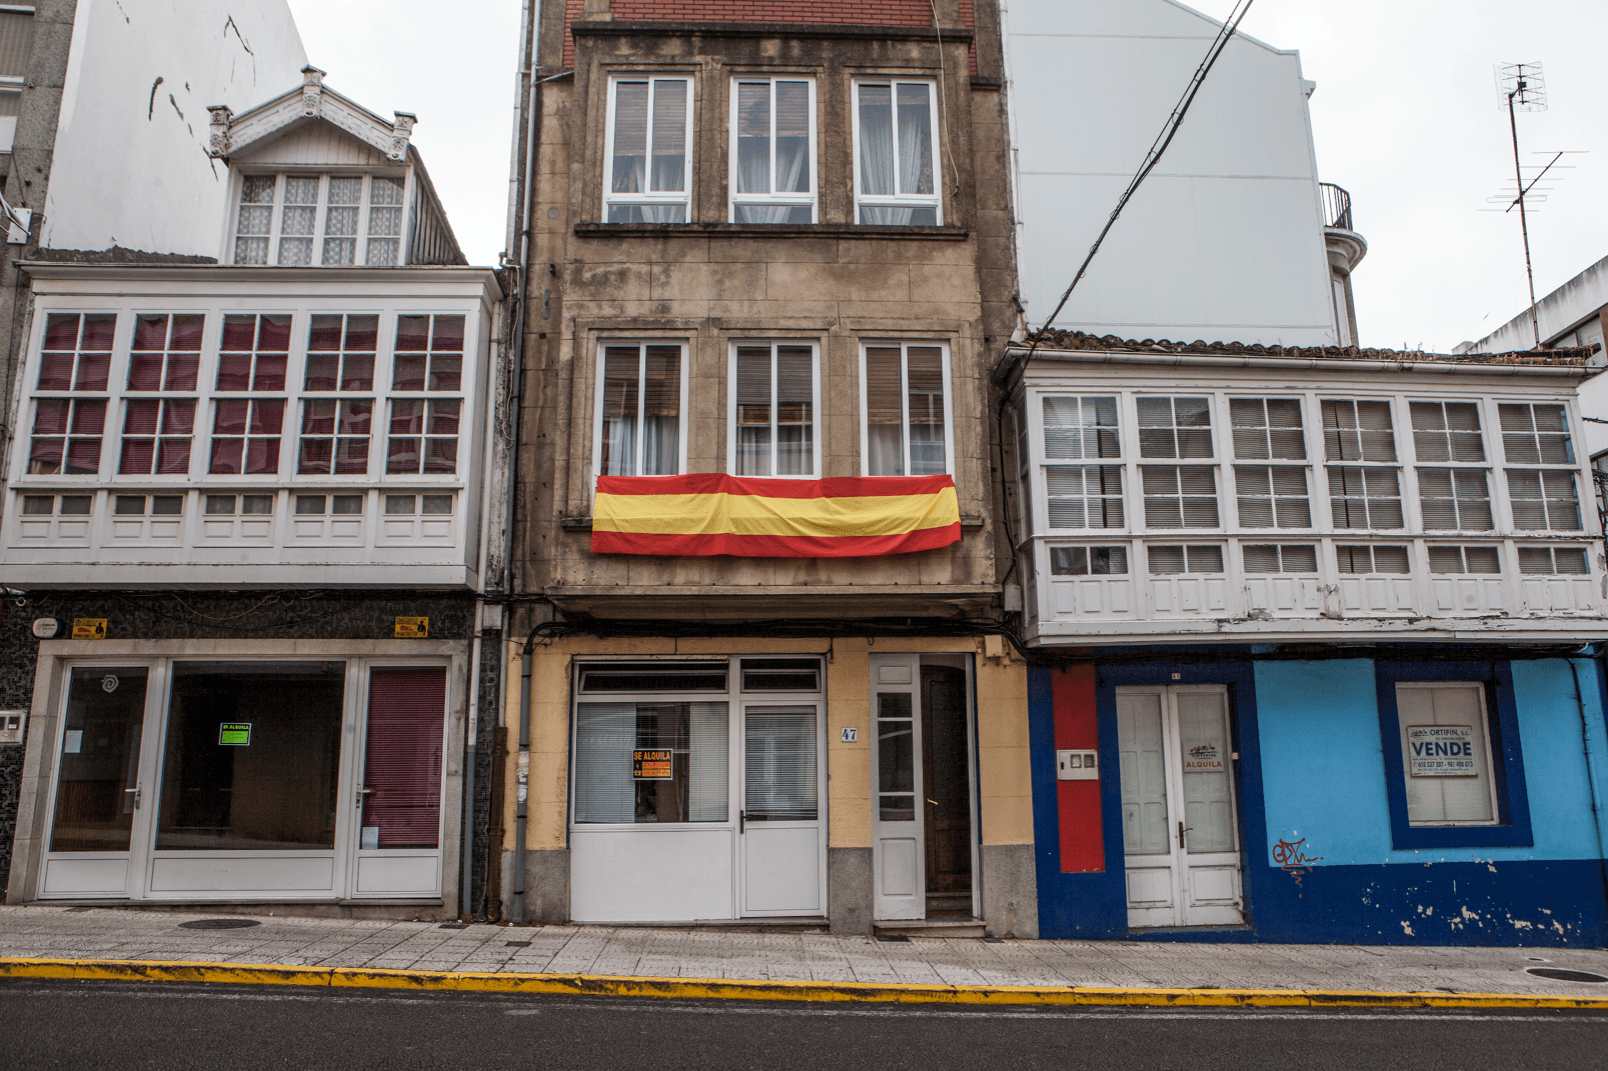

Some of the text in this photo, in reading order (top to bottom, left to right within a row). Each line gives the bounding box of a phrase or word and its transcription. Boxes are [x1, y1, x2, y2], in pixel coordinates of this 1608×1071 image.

[842, 728, 856, 740] 47
[1411, 741, 1472, 756] VENDE
[633, 751, 671, 760] SE ALQUILA
